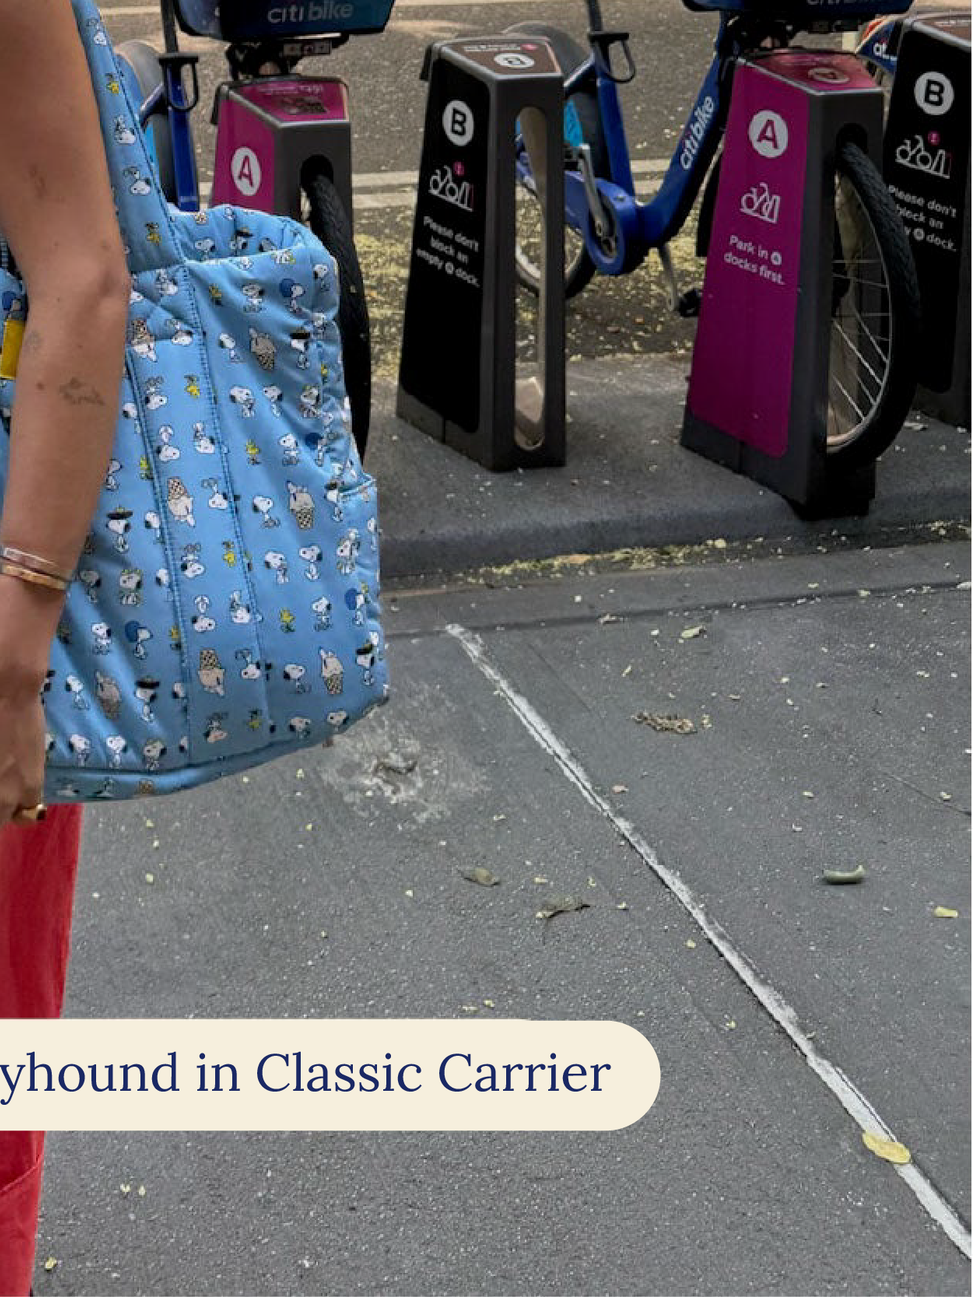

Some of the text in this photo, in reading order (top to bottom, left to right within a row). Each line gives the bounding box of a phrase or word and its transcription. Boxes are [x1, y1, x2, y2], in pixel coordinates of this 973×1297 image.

[924, 78, 946, 107] B
[451, 107, 467, 137] B
[757, 119, 778, 150] A
[238, 154, 253, 188] A
[929, 217, 944, 230] an
[729, 234, 755, 255] Park
[757, 244, 769, 260] in
[723, 251, 757, 273] docks
[759, 265, 786, 285] first.
